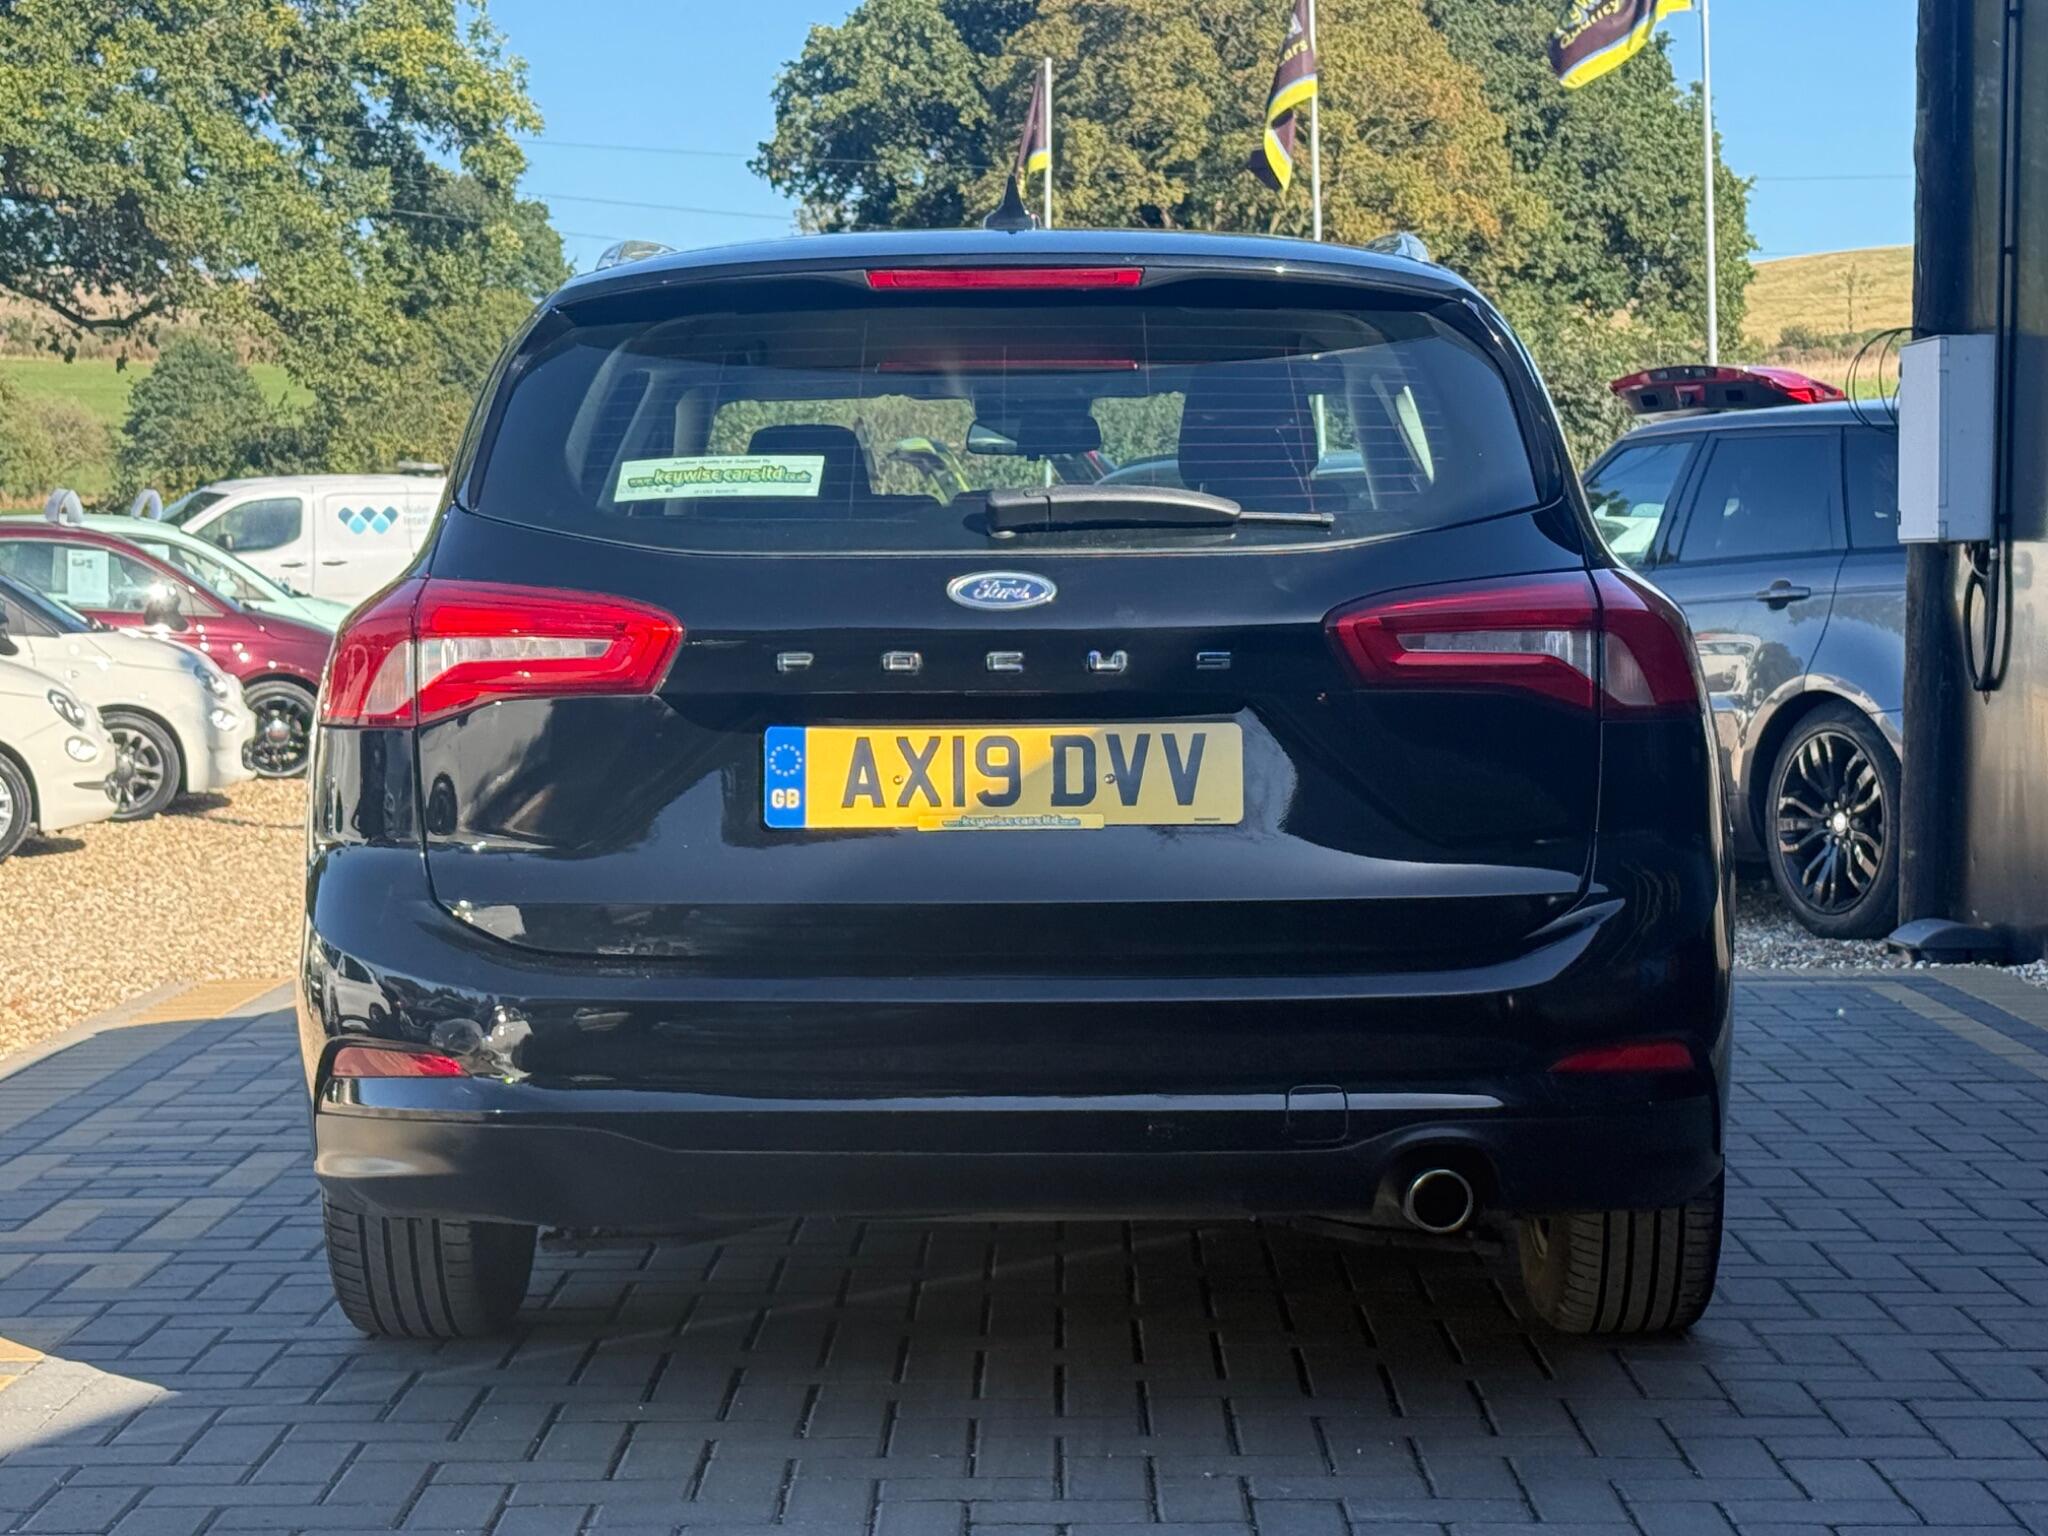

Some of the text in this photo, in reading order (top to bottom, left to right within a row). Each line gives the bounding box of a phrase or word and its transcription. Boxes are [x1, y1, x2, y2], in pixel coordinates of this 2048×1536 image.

[973, 578, 1031, 600] Ford
[776, 650, 1233, 674] FOCUS
[841, 733, 1208, 808] AX19 DVV
[772, 788, 800, 809] GB
